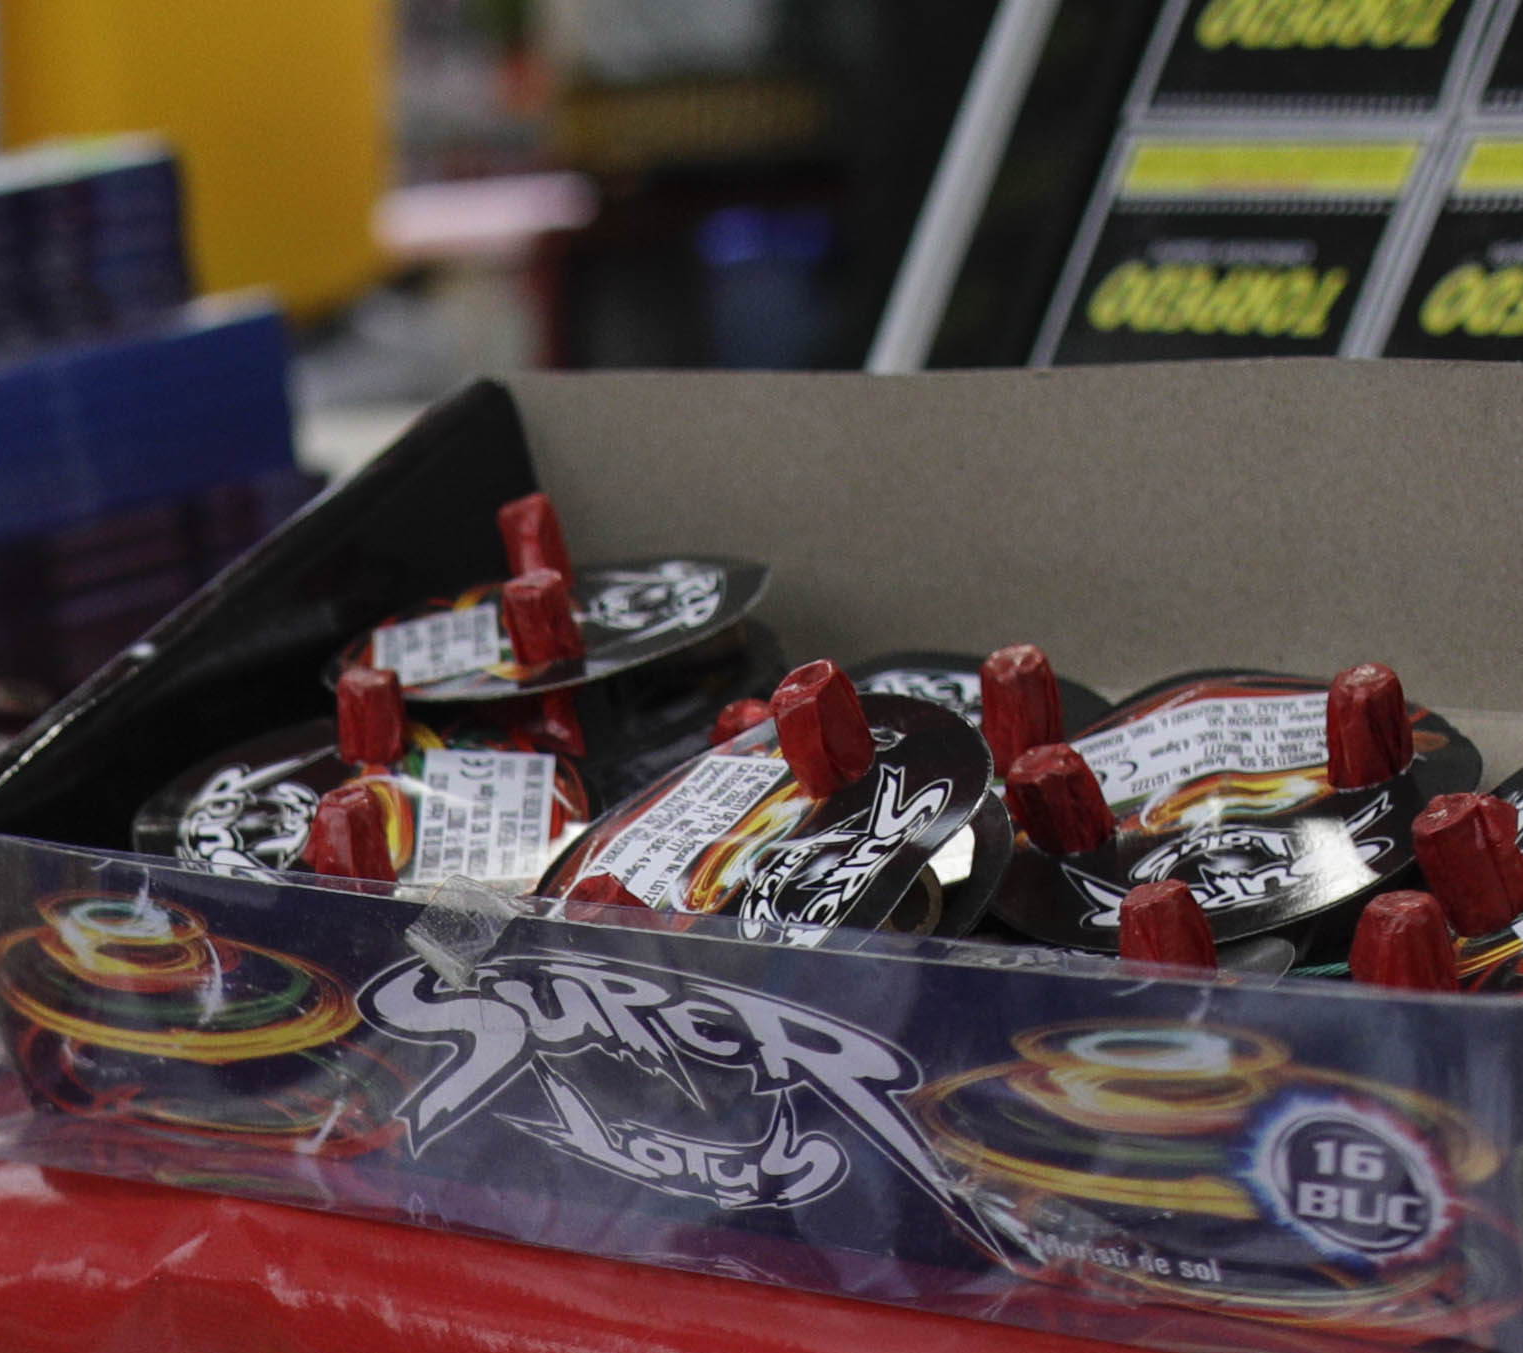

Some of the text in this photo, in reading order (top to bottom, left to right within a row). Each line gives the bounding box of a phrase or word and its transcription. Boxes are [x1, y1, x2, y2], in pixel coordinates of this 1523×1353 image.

[1312, 1141, 1387, 1181] 16
[1298, 1183, 1423, 1232] BUC
[1179, 1256, 1225, 1284] sol
